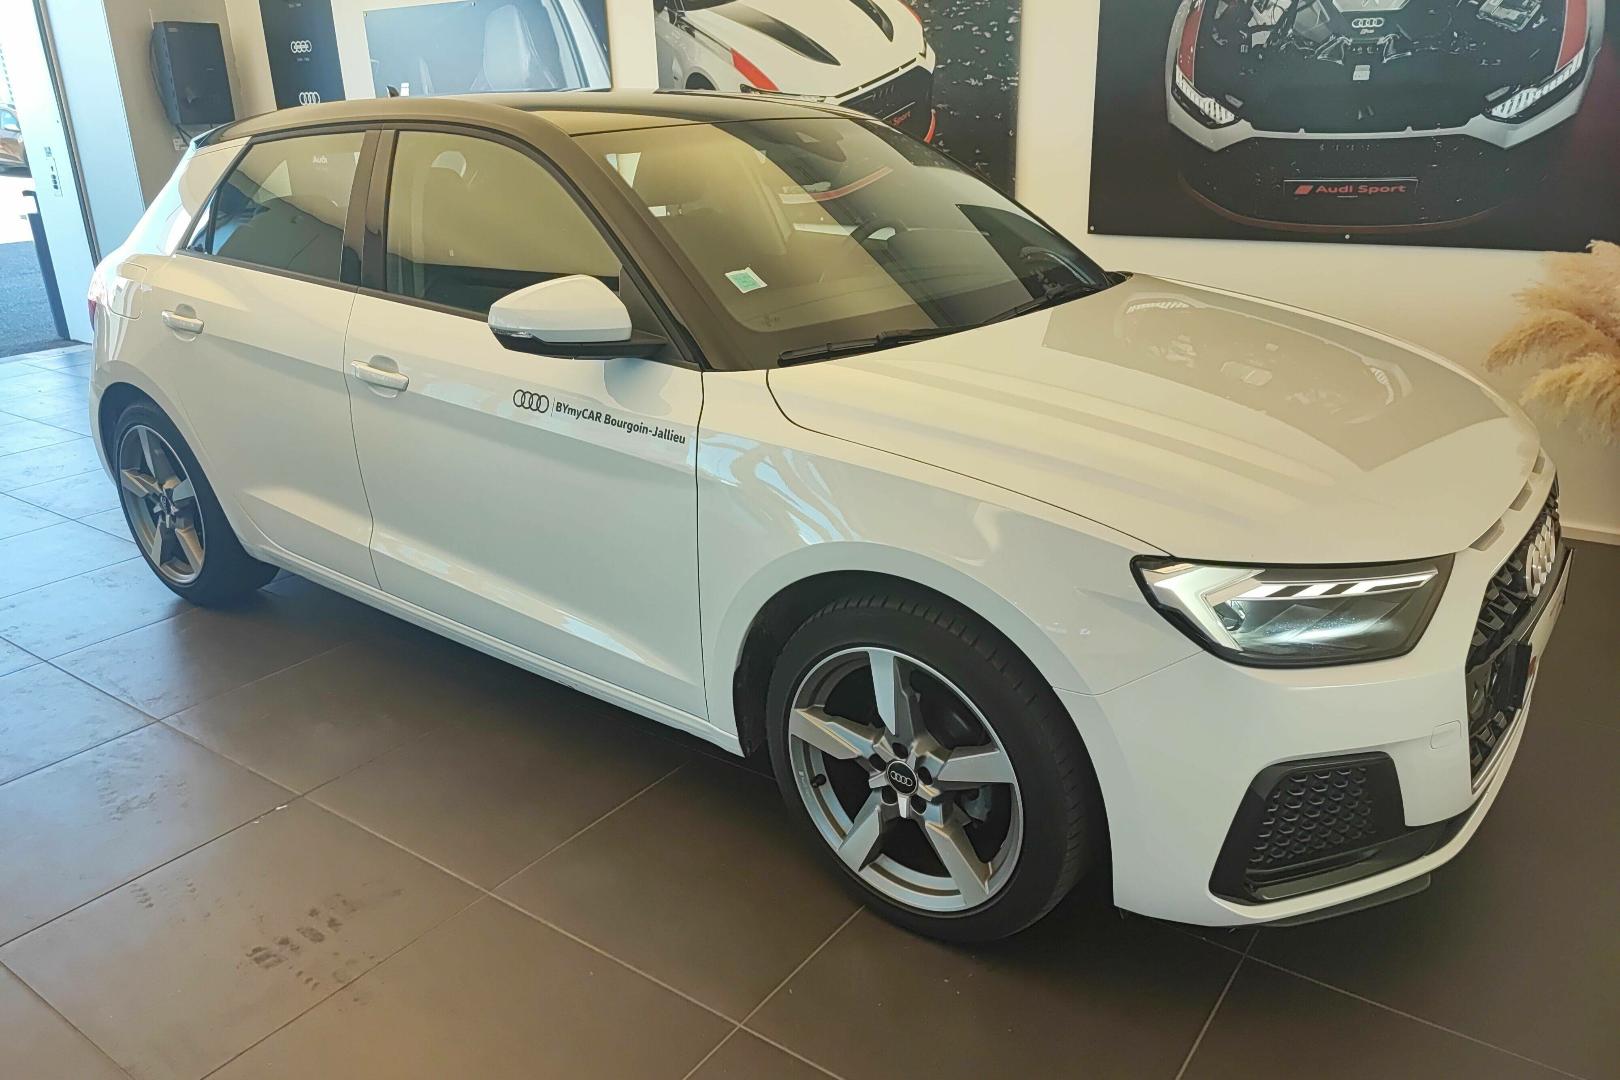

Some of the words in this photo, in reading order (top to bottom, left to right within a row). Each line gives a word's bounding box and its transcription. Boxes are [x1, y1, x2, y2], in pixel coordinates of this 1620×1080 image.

[1315, 184, 1353, 194] Audi
[1357, 184, 1407, 195] Sport
[555, 401, 602, 423] BYmyCAR
[603, 414, 686, 444] Bourgoin-Jallieu
